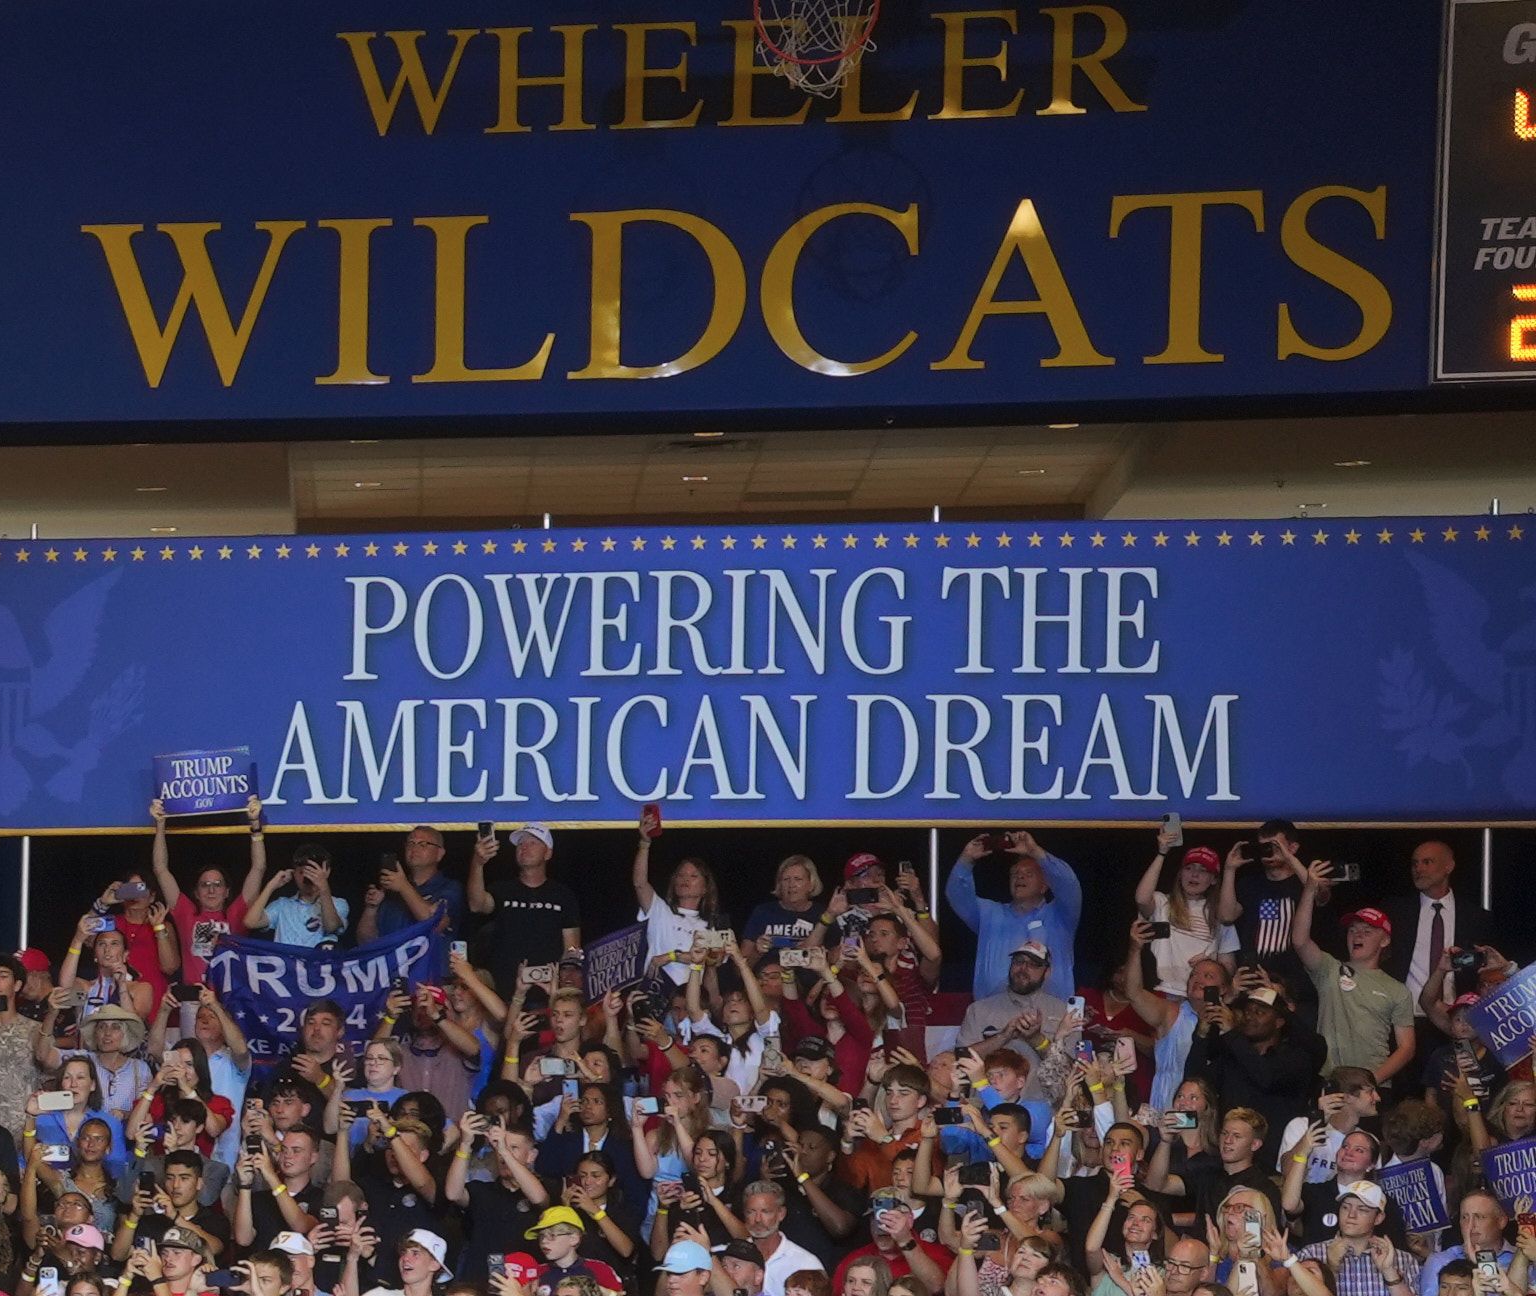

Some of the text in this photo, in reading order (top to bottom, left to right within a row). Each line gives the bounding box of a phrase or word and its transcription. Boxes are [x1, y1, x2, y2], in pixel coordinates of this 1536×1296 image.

[336, 2, 1149, 135] WHEELER
[81, 186, 1394, 388] WILDCATS
[343, 565, 1159, 680] POWERING THE
[160, 774, 249, 800] ACCOUNTS
[171, 756, 233, 779] TRUMP
[259, 693, 1239, 807] AMERICAN DREAM
[211, 936, 430, 998] TRUMP
[276, 1004, 367, 1032] 24
